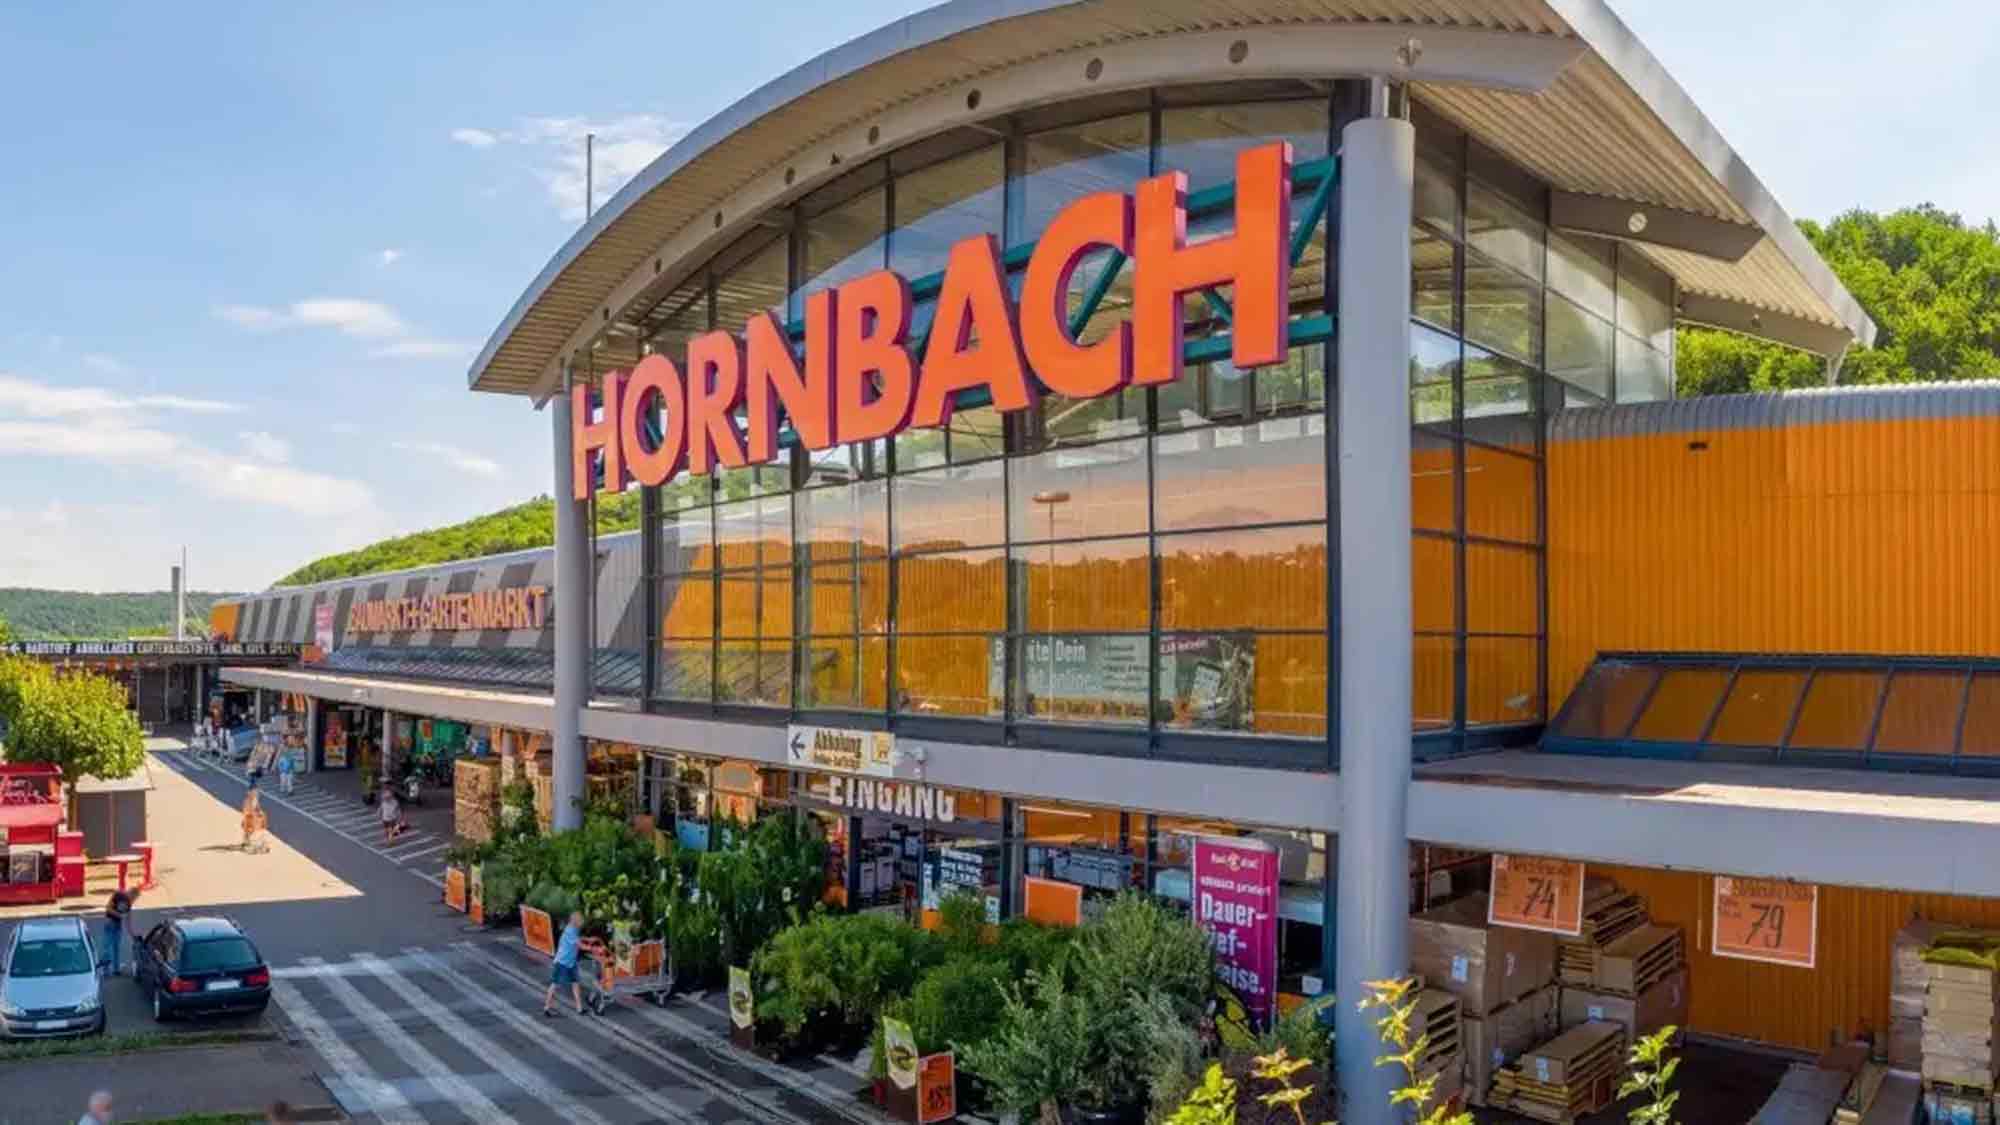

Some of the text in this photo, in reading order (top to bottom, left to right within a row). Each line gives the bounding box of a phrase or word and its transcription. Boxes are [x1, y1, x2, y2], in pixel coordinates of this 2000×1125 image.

[571, 139, 1294, 500] HORNBACH
[1055, 637, 1087, 662] Dein
[829, 775, 955, 822] EINGANG
[1201, 891, 1269, 928] Dauer-
[1521, 877, 1555, 919] 74
[1744, 903, 1785, 948] 79
[1216, 959, 1265, 993] eise.
